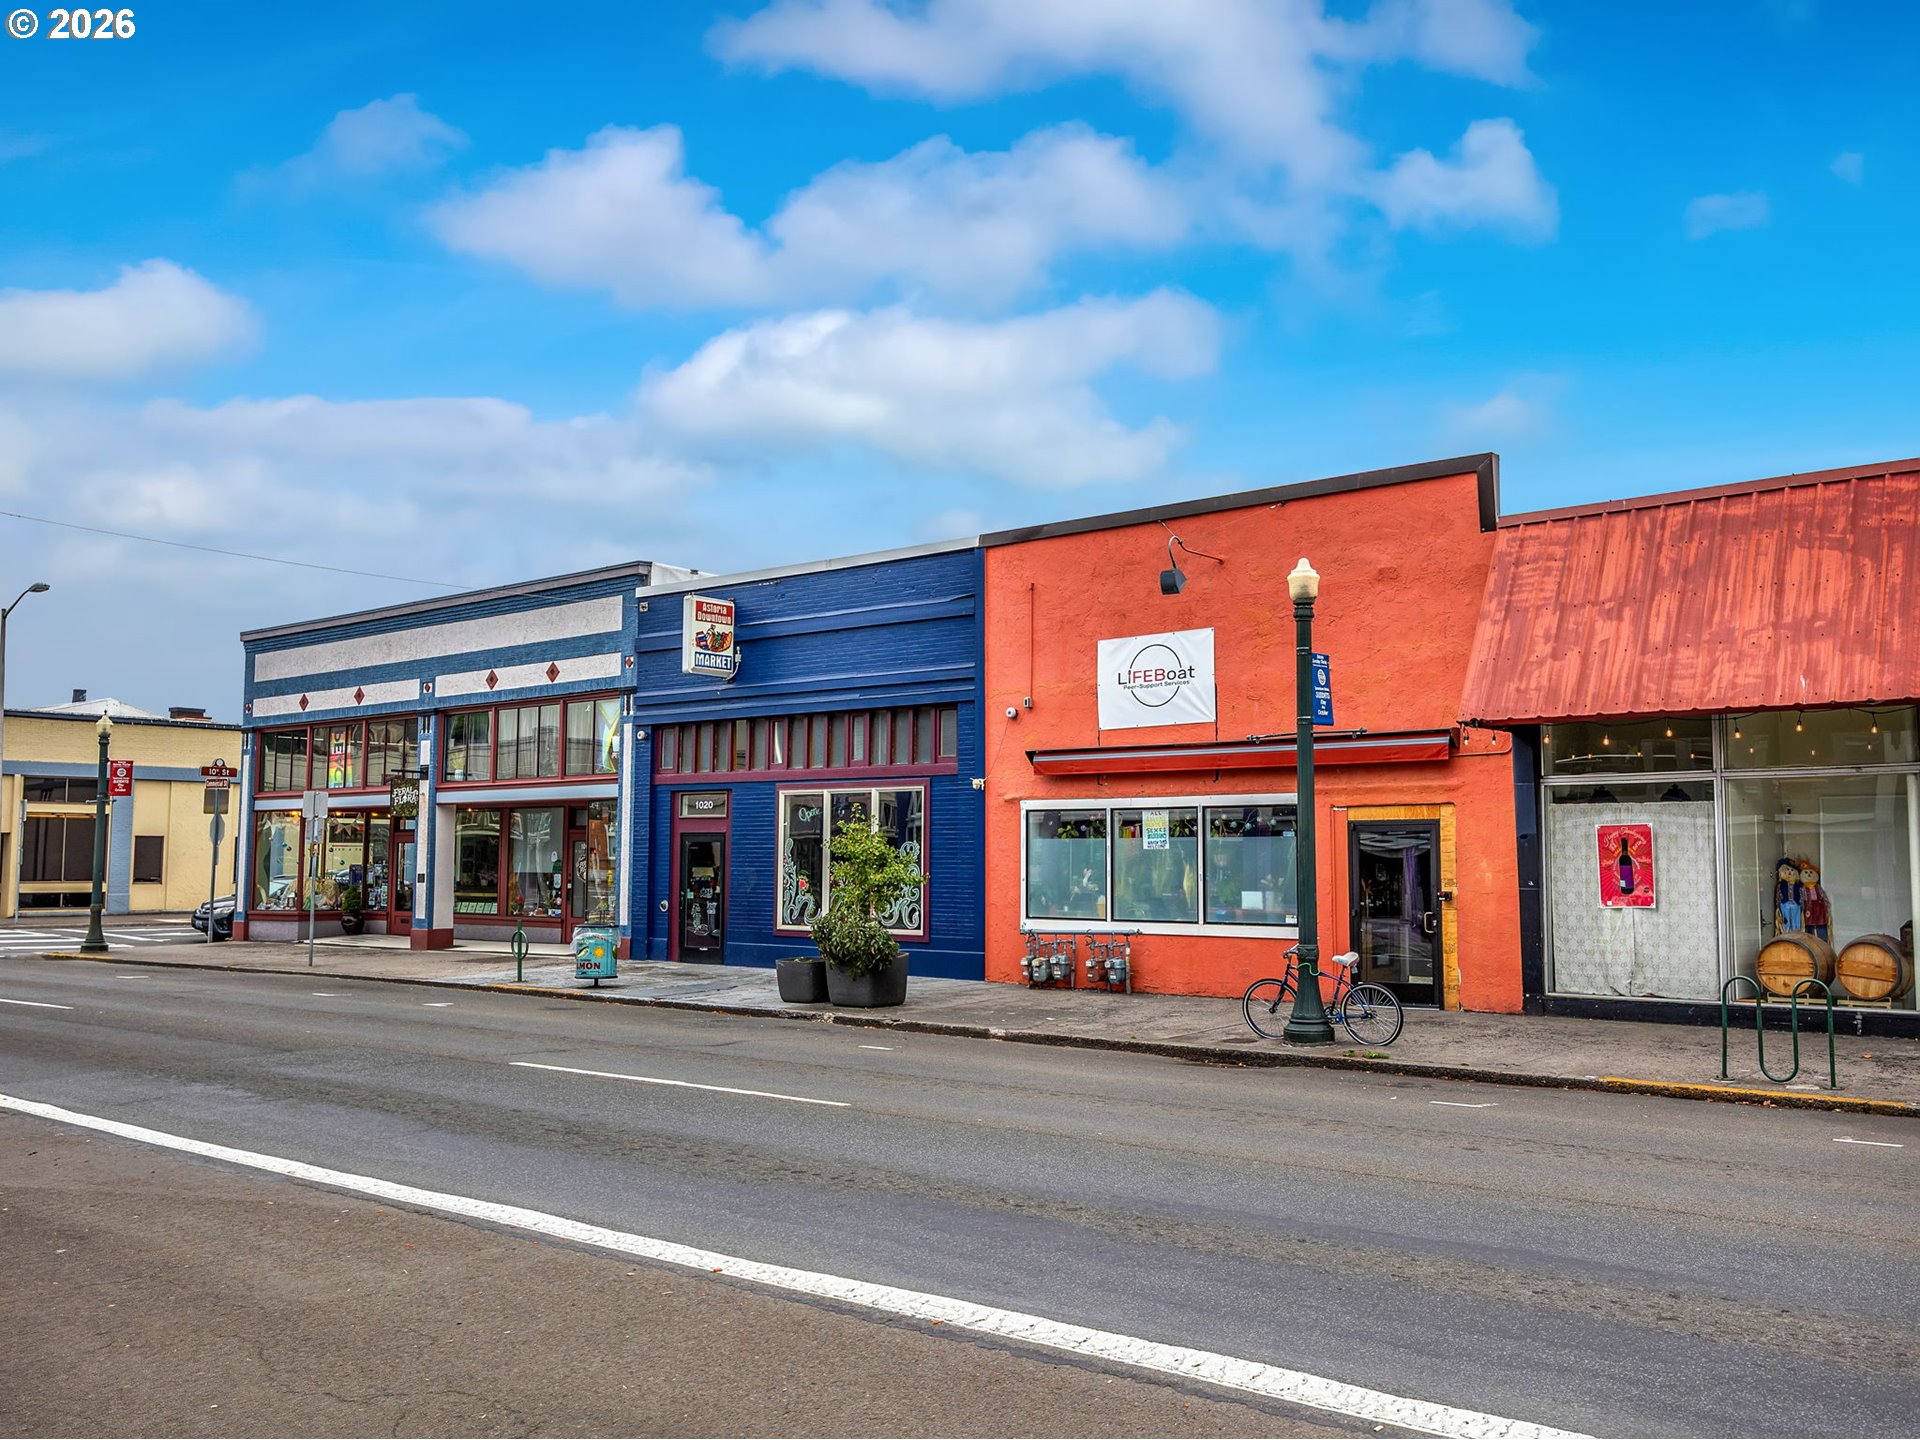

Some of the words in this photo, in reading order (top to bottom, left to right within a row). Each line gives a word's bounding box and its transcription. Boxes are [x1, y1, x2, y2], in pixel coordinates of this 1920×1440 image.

[702, 603, 727, 615] Astoria
[697, 611, 732, 624] Downtown
[695, 653, 732, 669] MARKET
[1123, 682, 1163, 690] Peer-Support
[1164, 679, 1190, 688] Services
[695, 800, 714, 810] 1020
[577, 962, 601, 970] MON
